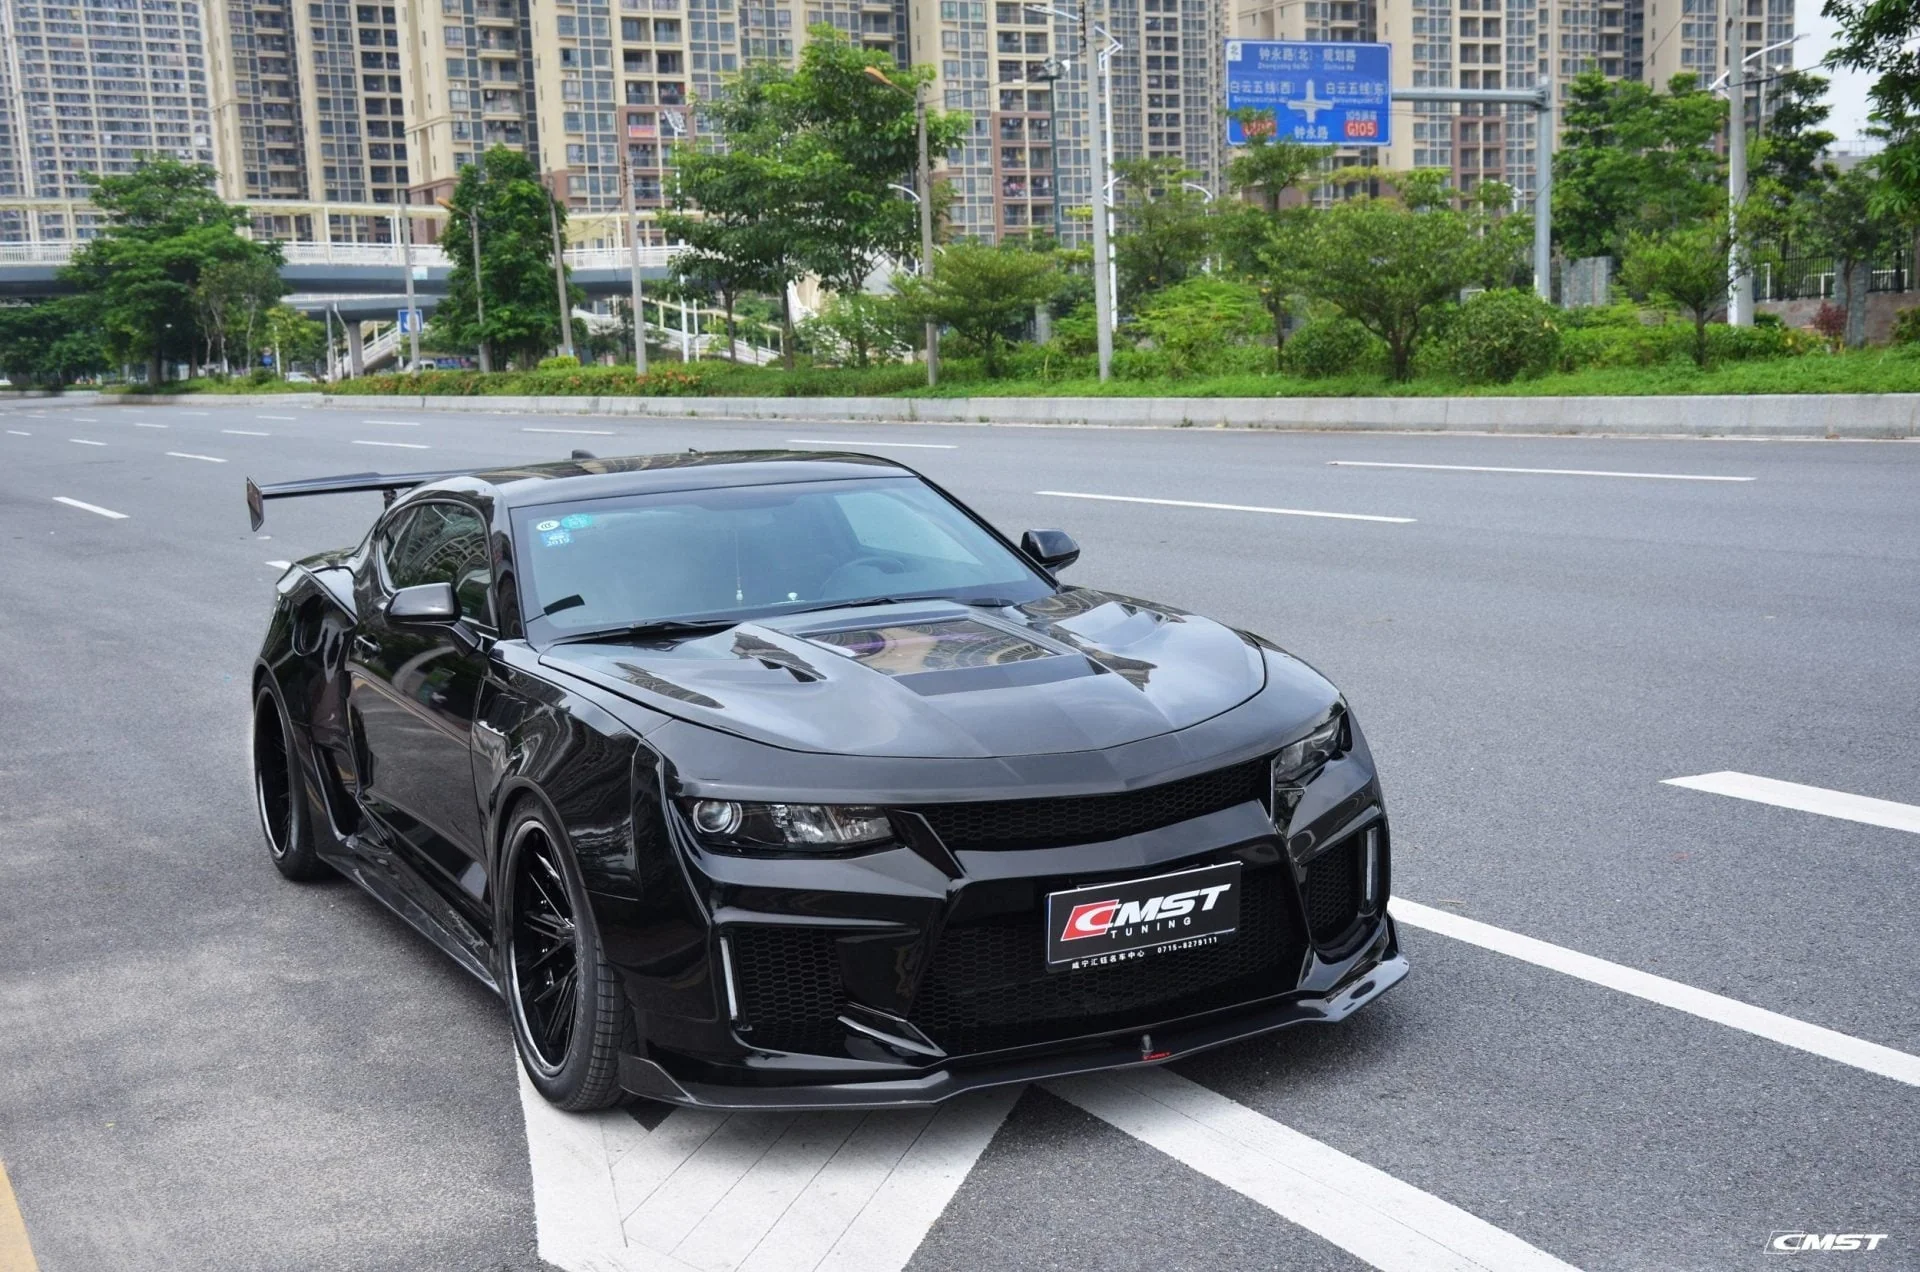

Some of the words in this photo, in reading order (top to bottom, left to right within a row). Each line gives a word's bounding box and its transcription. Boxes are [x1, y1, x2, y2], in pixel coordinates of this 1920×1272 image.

[1294, 125, 1328, 140] 钟永路
[1347, 122, 1375, 137] G105
[1075, 884, 1231, 931] CMST
[1111, 917, 1192, 939] TUNING
[1157, 936, 1217, 954] 0715-8279111
